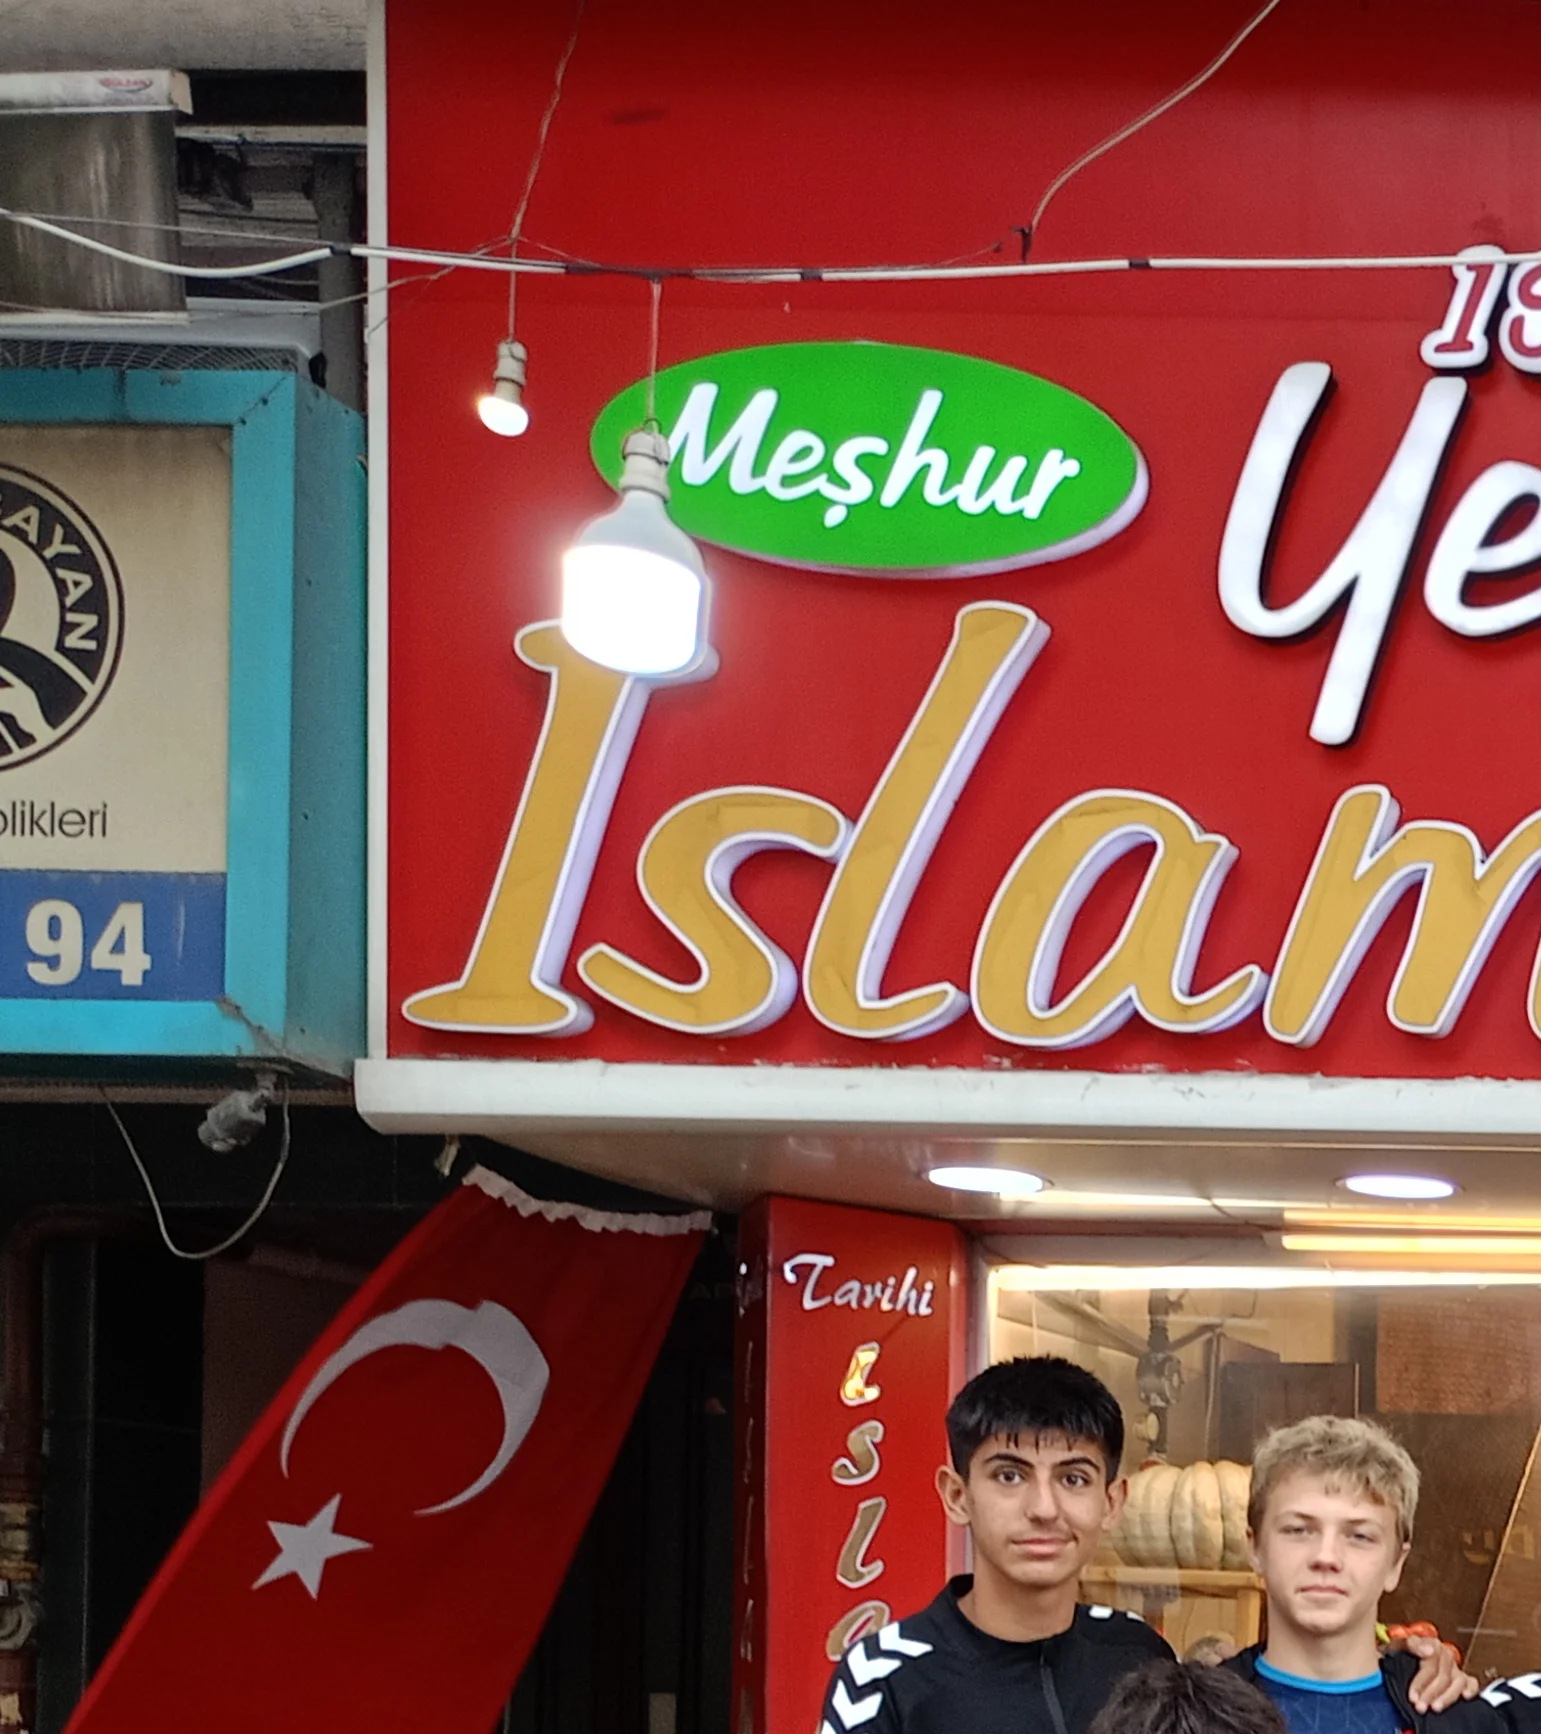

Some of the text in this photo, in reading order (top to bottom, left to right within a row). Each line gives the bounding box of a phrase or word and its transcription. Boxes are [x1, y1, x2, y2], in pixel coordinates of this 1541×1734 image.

[660, 382, 1081, 527] Meşhur
[0, 502, 101, 651] AYAN
[25, 899, 152, 986] 94
[784, 1253, 934, 1317] Tarihi
